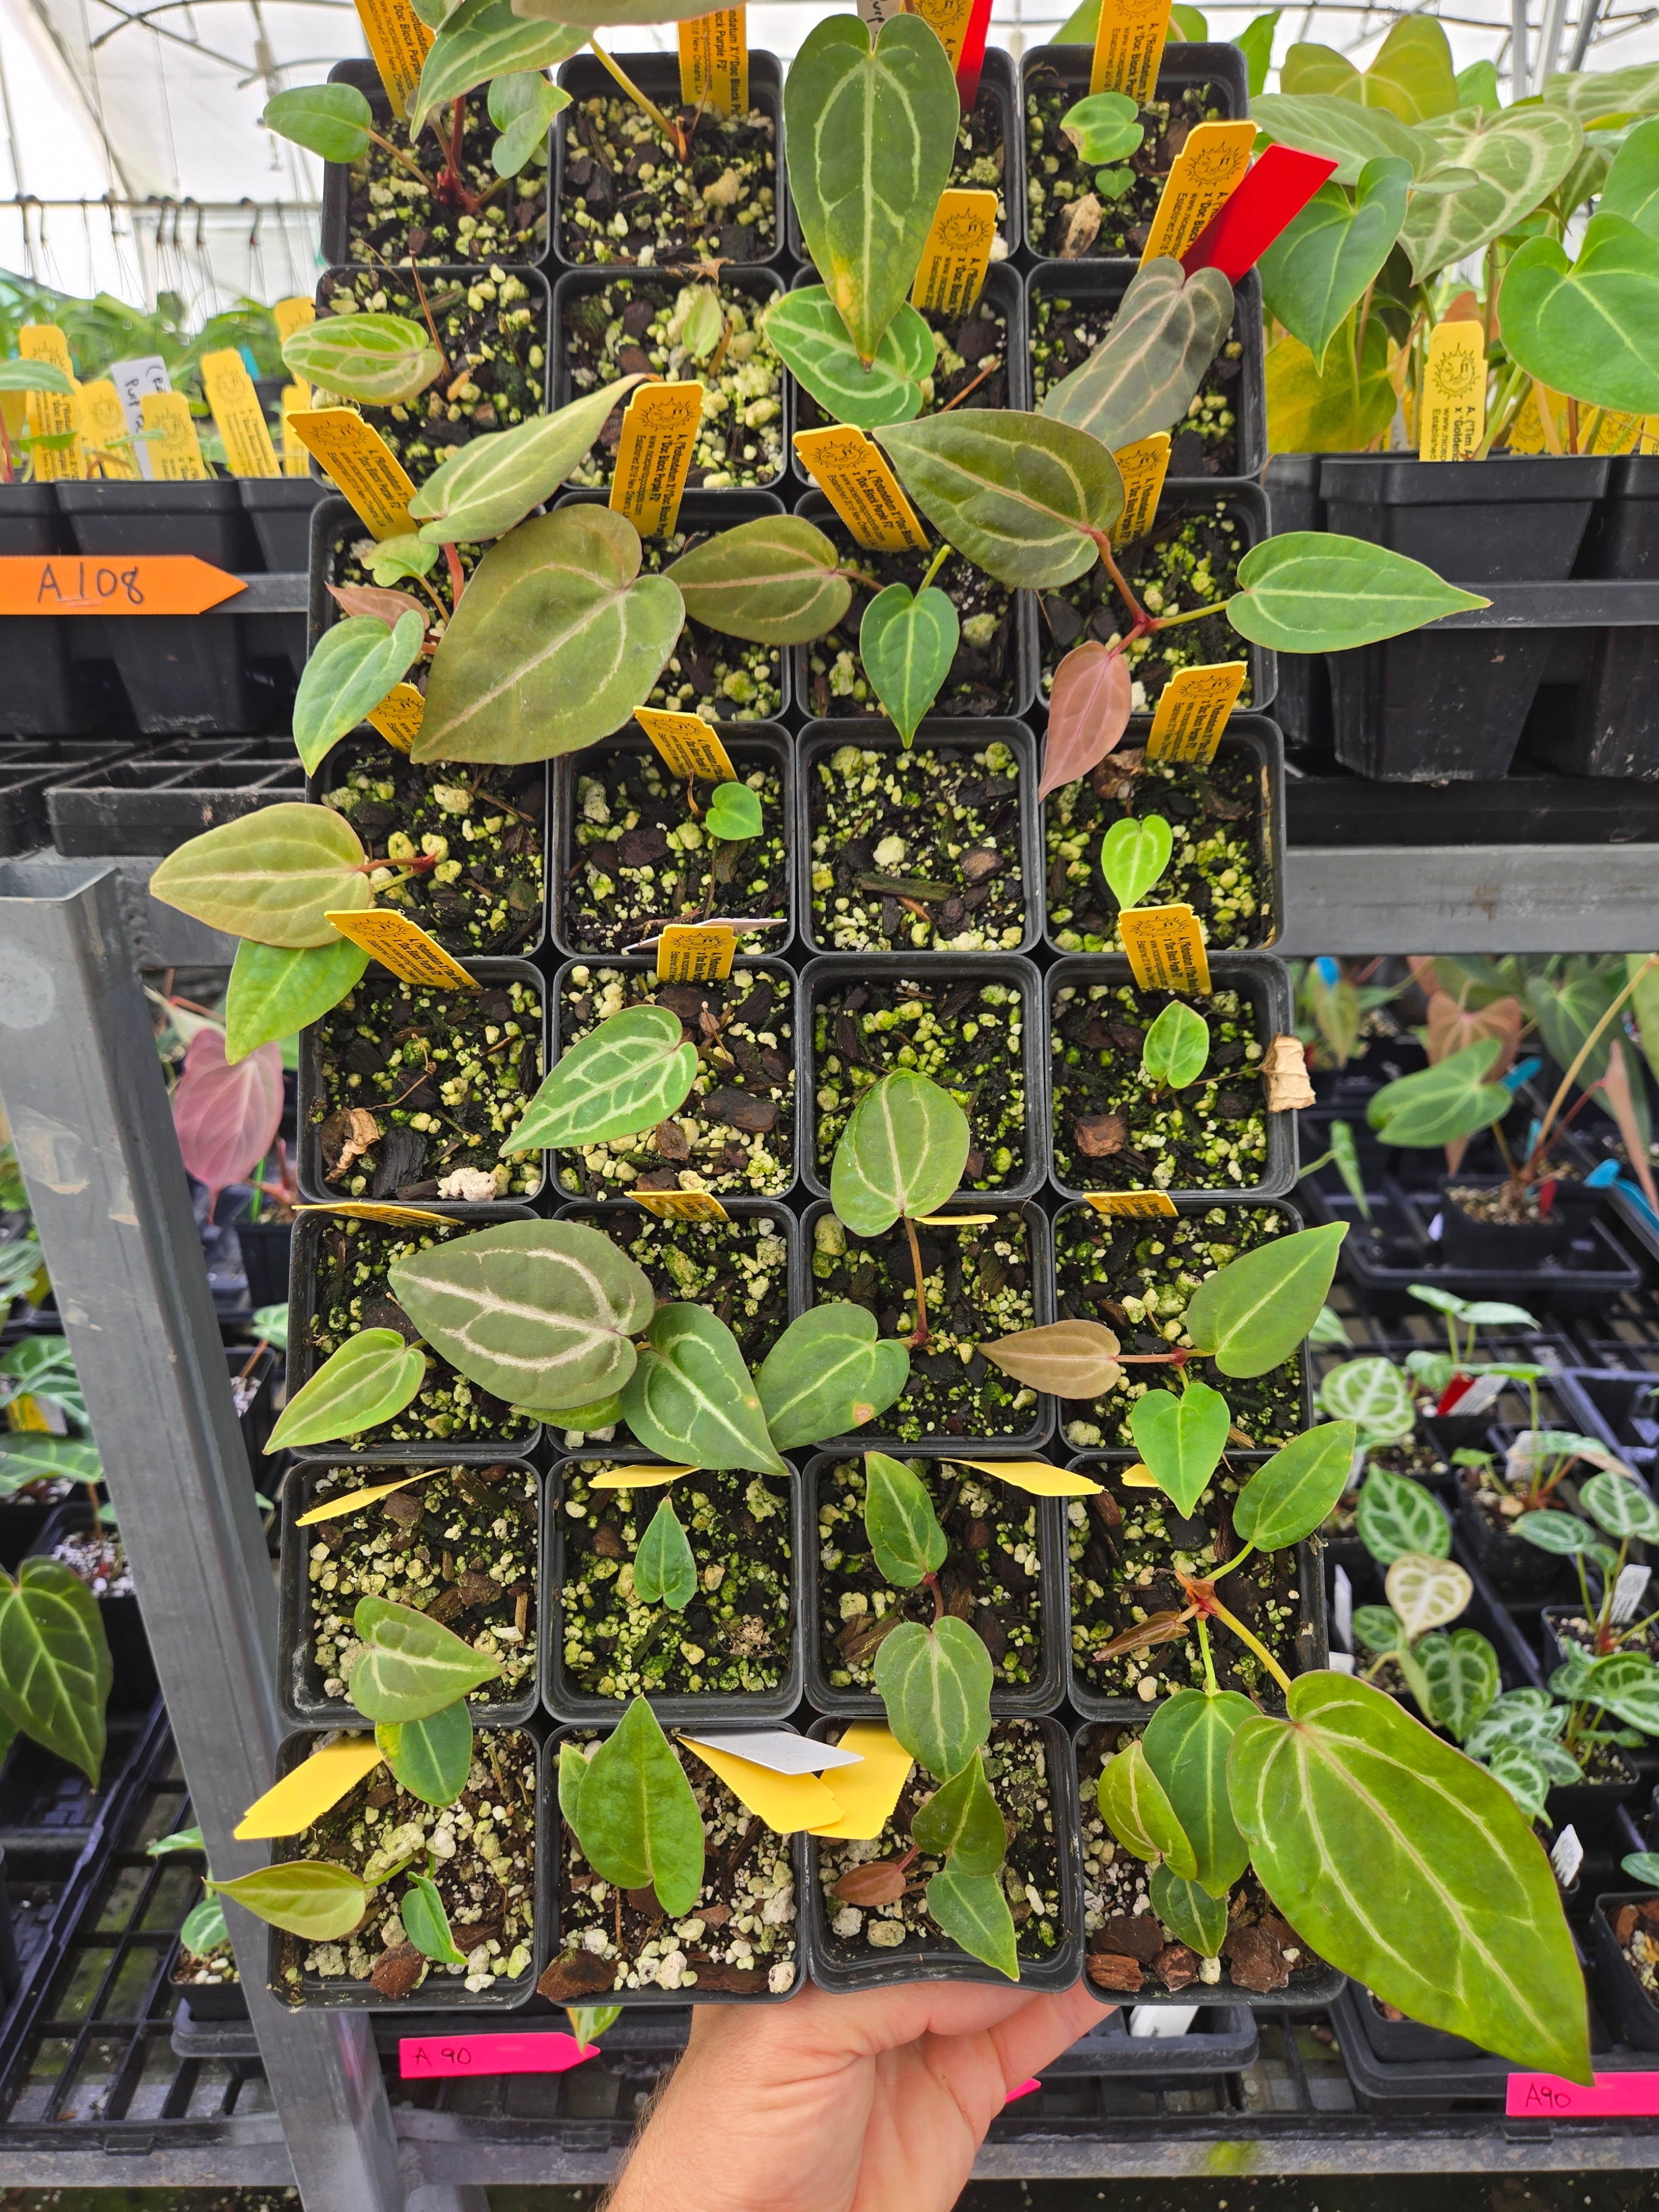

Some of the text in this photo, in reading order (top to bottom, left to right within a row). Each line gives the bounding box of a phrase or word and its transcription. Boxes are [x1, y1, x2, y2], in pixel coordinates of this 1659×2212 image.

[399, 23, 415, 46] Block
[692, 37, 700, 52] New
[714, 30, 726, 57] Purple
[1127, 53, 1141, 77] Block
[729, 78, 741, 102] Block
[1187, 220, 1205, 242] Block
[655, 455, 670, 472] Block
[650, 473, 666, 492] Purple
[862, 488, 879, 504] Block
[872, 503, 889, 521] Purple
[1525, 2082, 1571, 2109] A90
